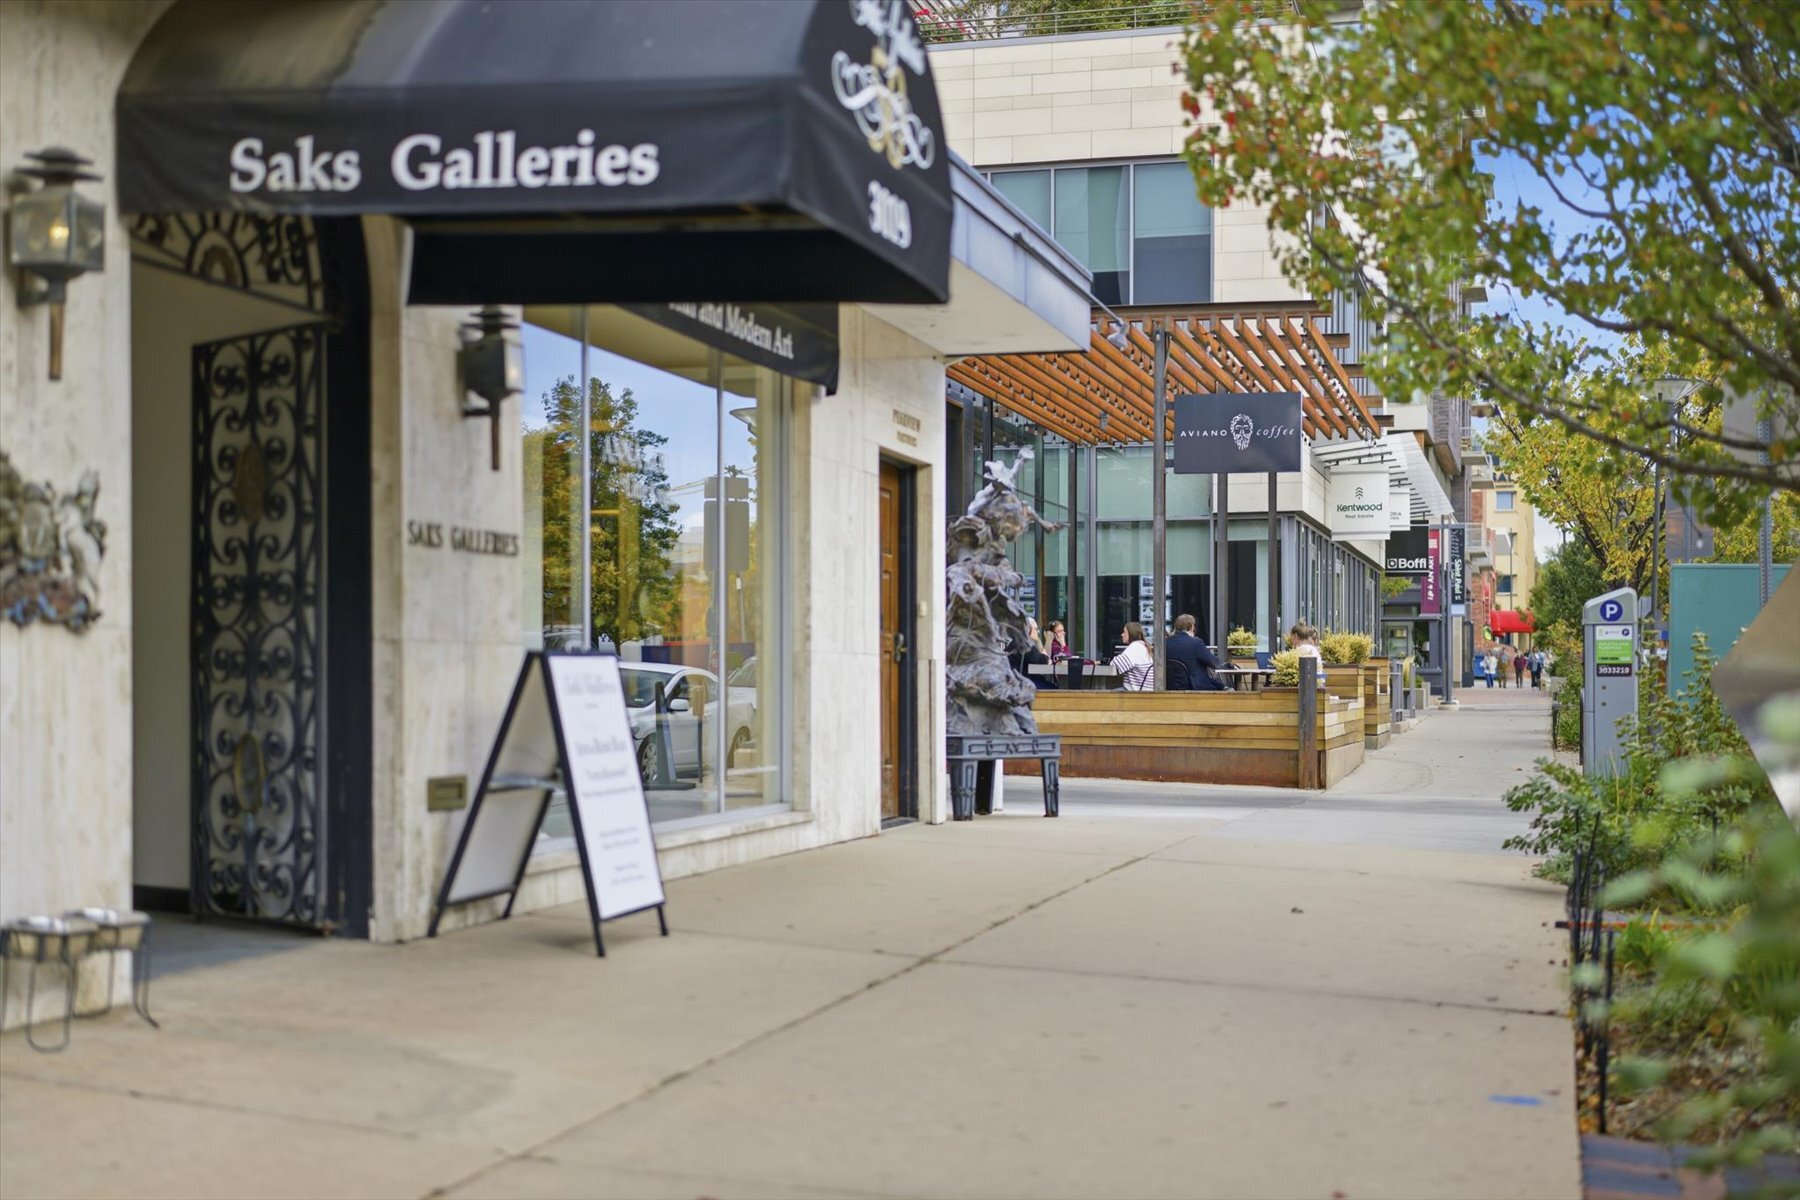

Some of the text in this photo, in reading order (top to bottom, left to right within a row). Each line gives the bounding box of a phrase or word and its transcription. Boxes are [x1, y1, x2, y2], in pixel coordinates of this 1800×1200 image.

[230, 128, 660, 192] Saks Galleries
[724, 302, 773, 352] Modern
[772, 325, 794, 360] Art
[1180, 425, 1295, 439] AVIANO coffee
[1336, 502, 1383, 512] Kentwood
[407, 519, 520, 558] SAKS GALLERIES
[1398, 557, 1427, 569] Boffi
[1454, 558, 1462, 577] Saint
[1454, 578, 1462, 594] Paul
[1605, 604, 1618, 619] P
